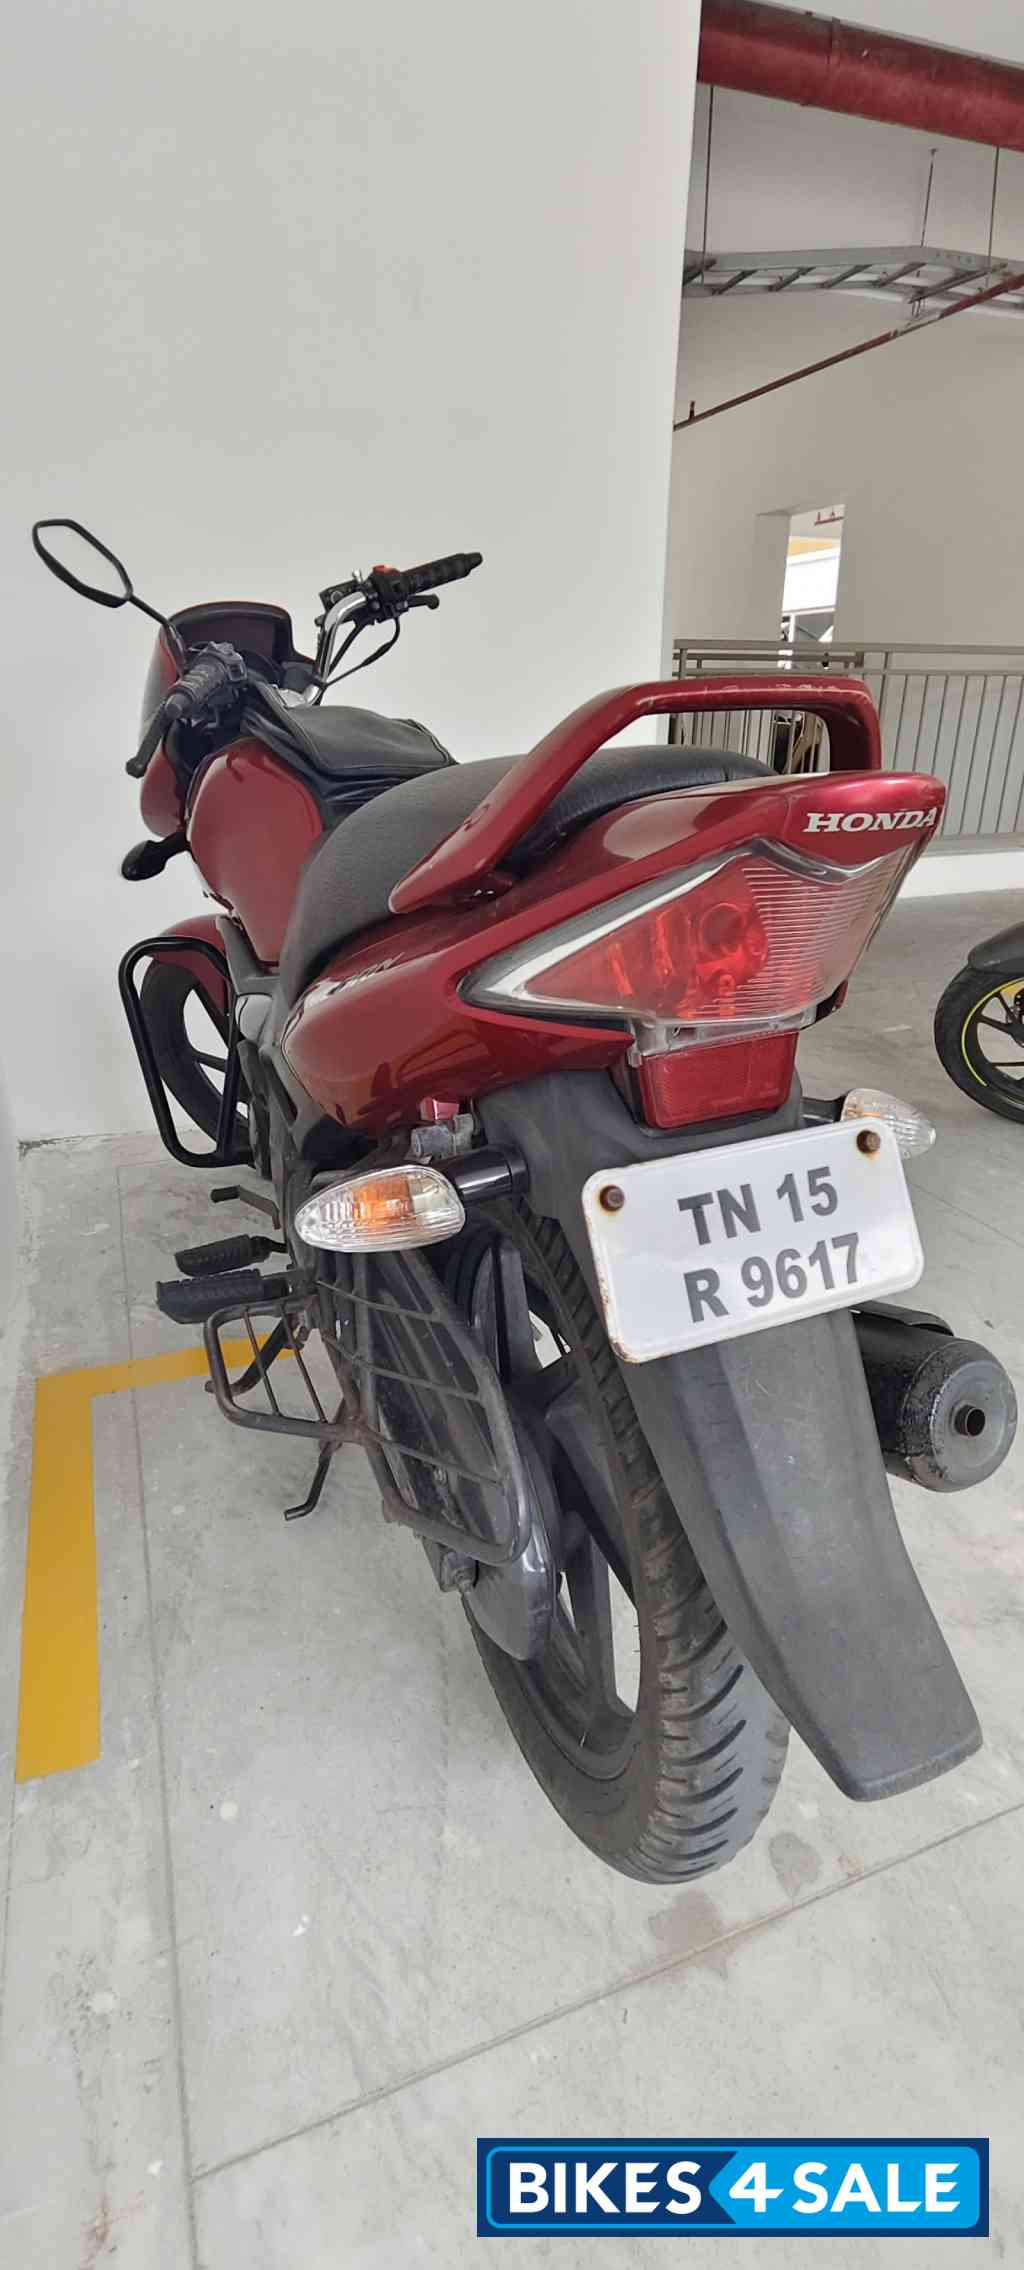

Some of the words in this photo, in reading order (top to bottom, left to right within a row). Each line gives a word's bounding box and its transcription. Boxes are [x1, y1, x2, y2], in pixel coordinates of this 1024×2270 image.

[802, 807, 937, 833] HONDA
[677, 1183, 761, 1246] TN
[776, 1166, 838, 1223] 15
[683, 1268, 730, 1323] R
[741, 1232, 860, 1308] 9617
